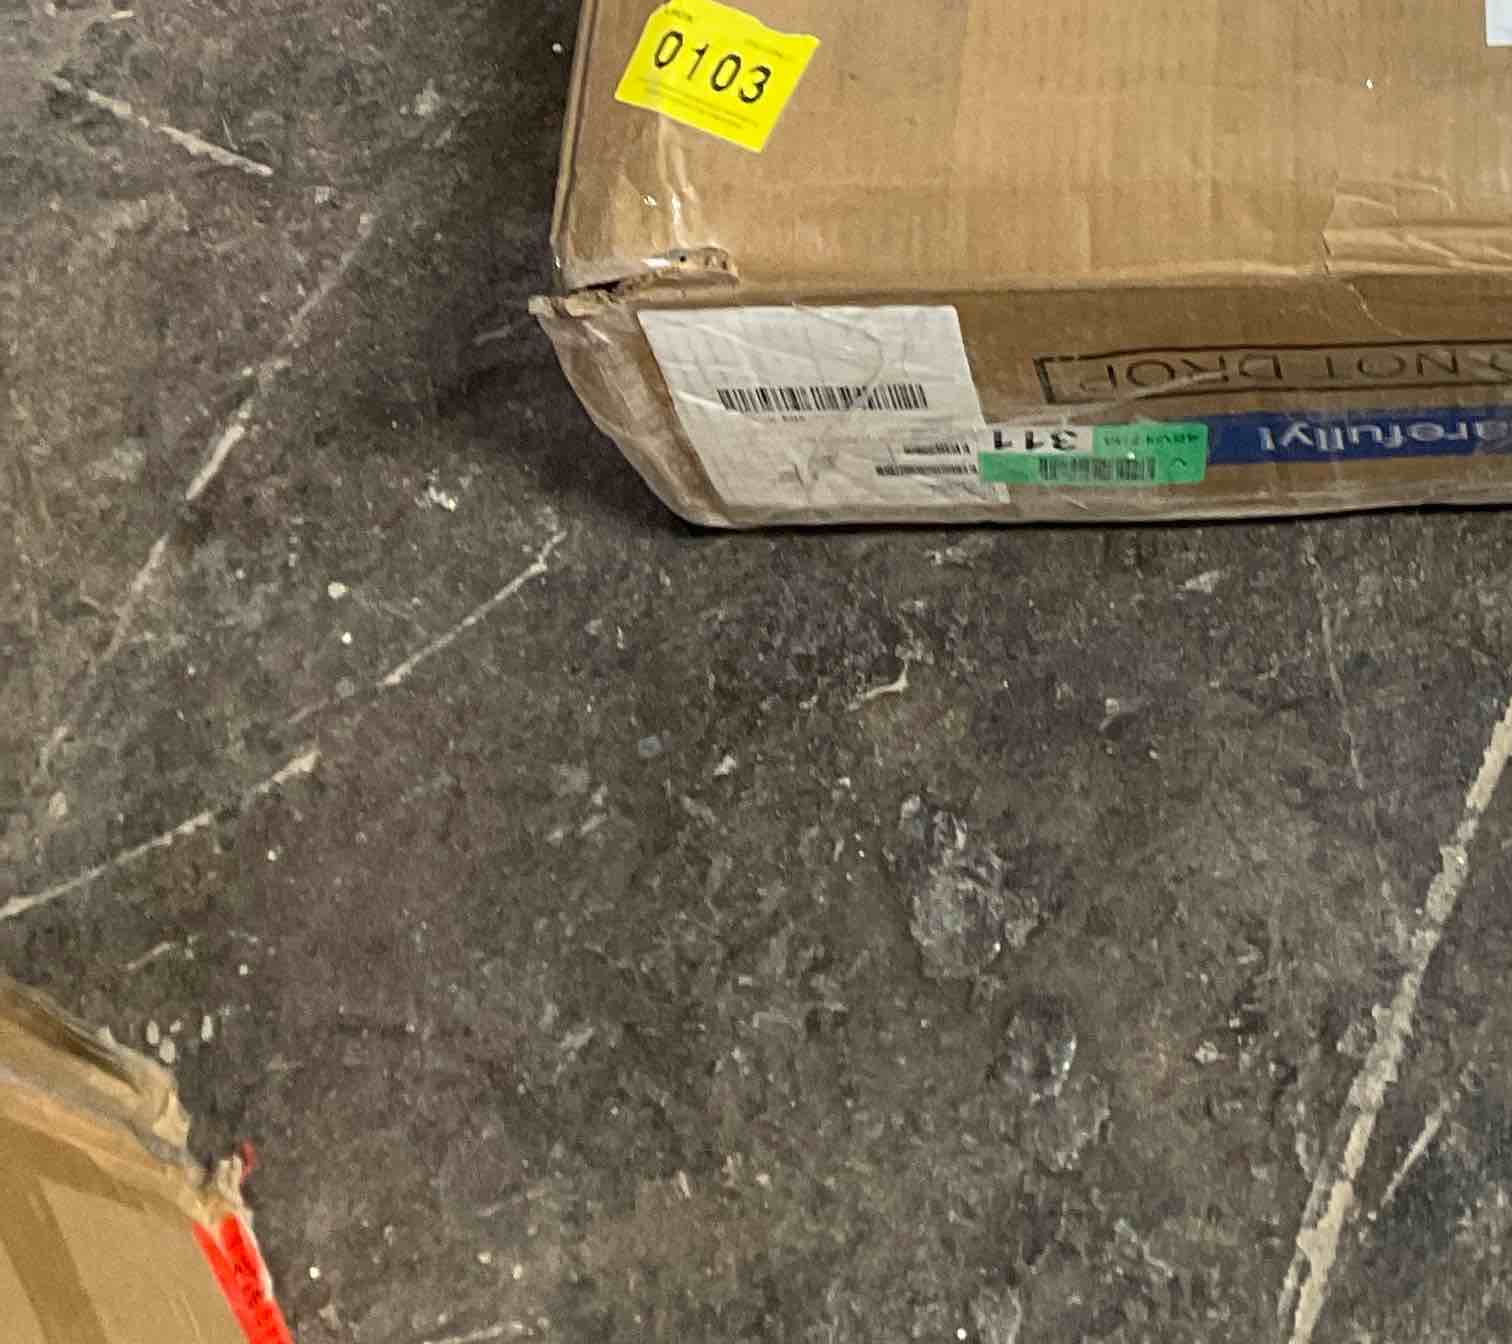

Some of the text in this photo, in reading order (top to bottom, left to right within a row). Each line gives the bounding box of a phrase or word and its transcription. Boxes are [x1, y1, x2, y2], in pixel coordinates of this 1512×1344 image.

[654, 30, 772, 104] 0103
[1322, 349, 1459, 379] NOT
[993, 430, 1078, 452] 311
